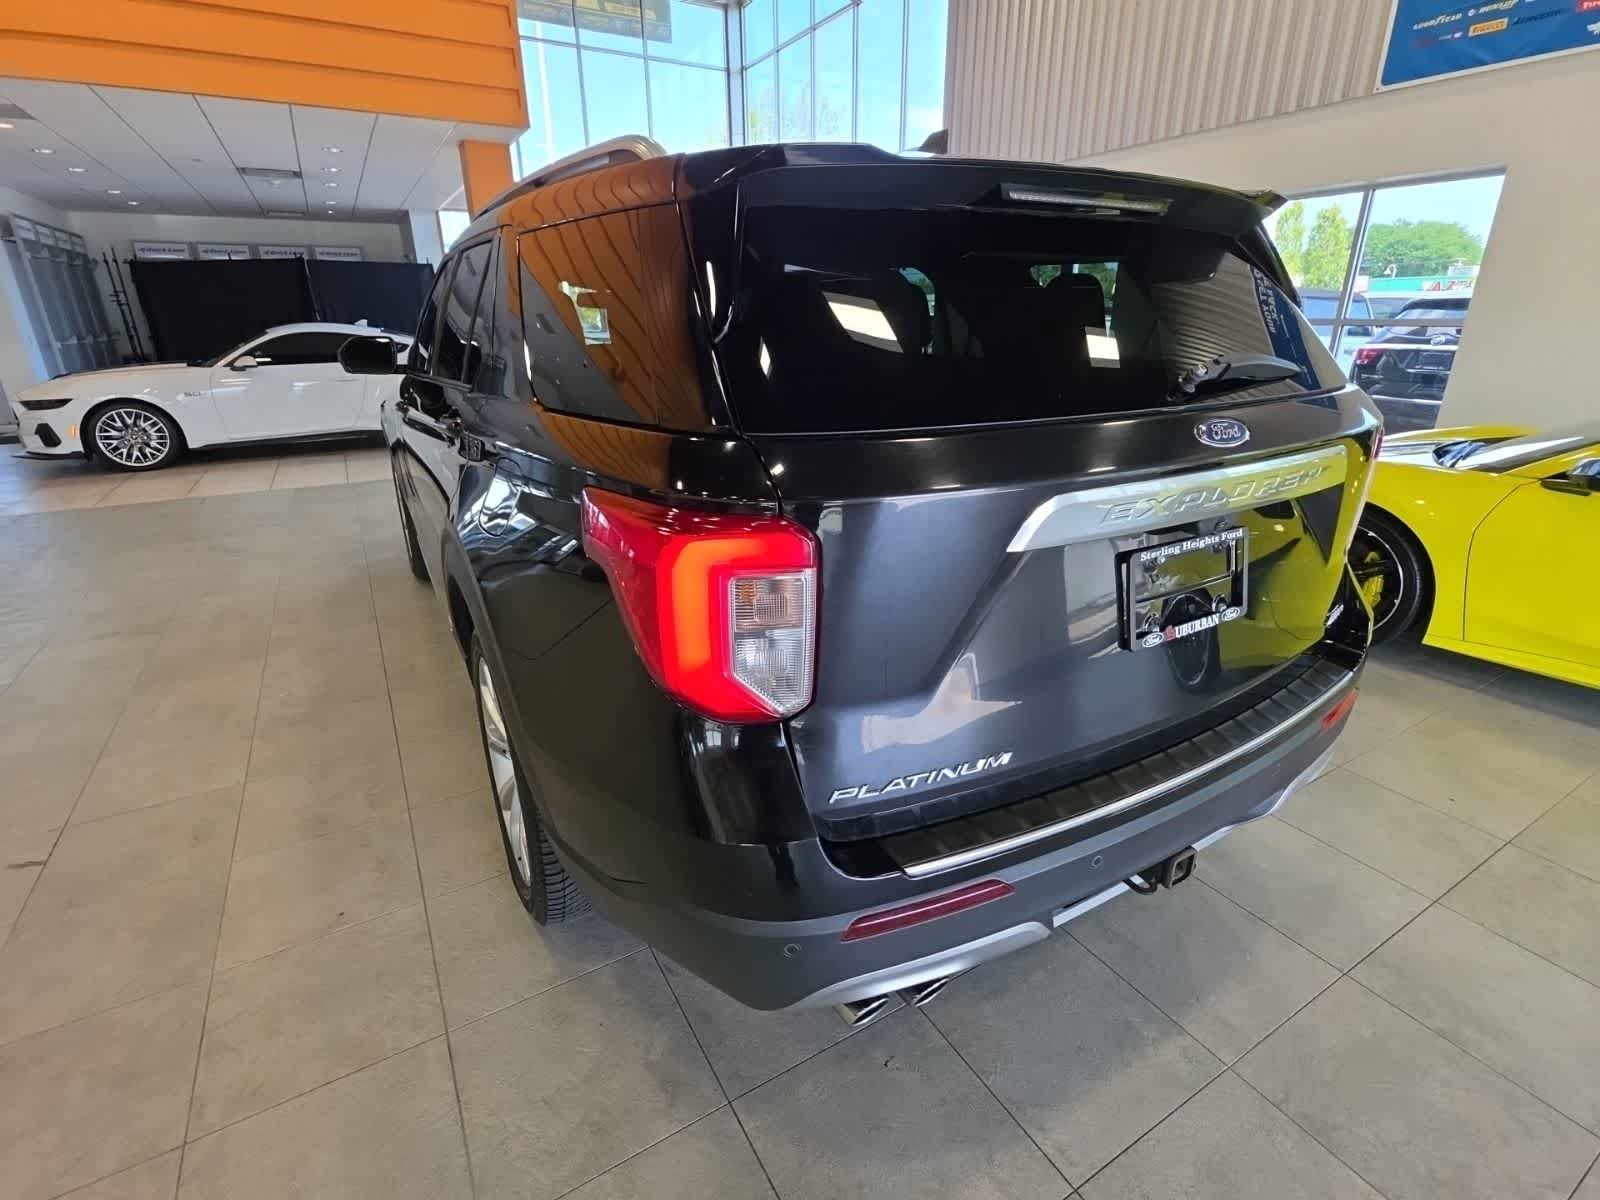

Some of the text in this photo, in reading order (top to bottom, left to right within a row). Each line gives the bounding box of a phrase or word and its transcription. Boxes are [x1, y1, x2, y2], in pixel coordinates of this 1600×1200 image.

[1210, 422, 1241, 440] Ford
[1101, 466, 1326, 524] EXPLORER
[1140, 527, 1243, 562] Sterling Heights Ford
[828, 751, 1014, 804] PLATINUM
